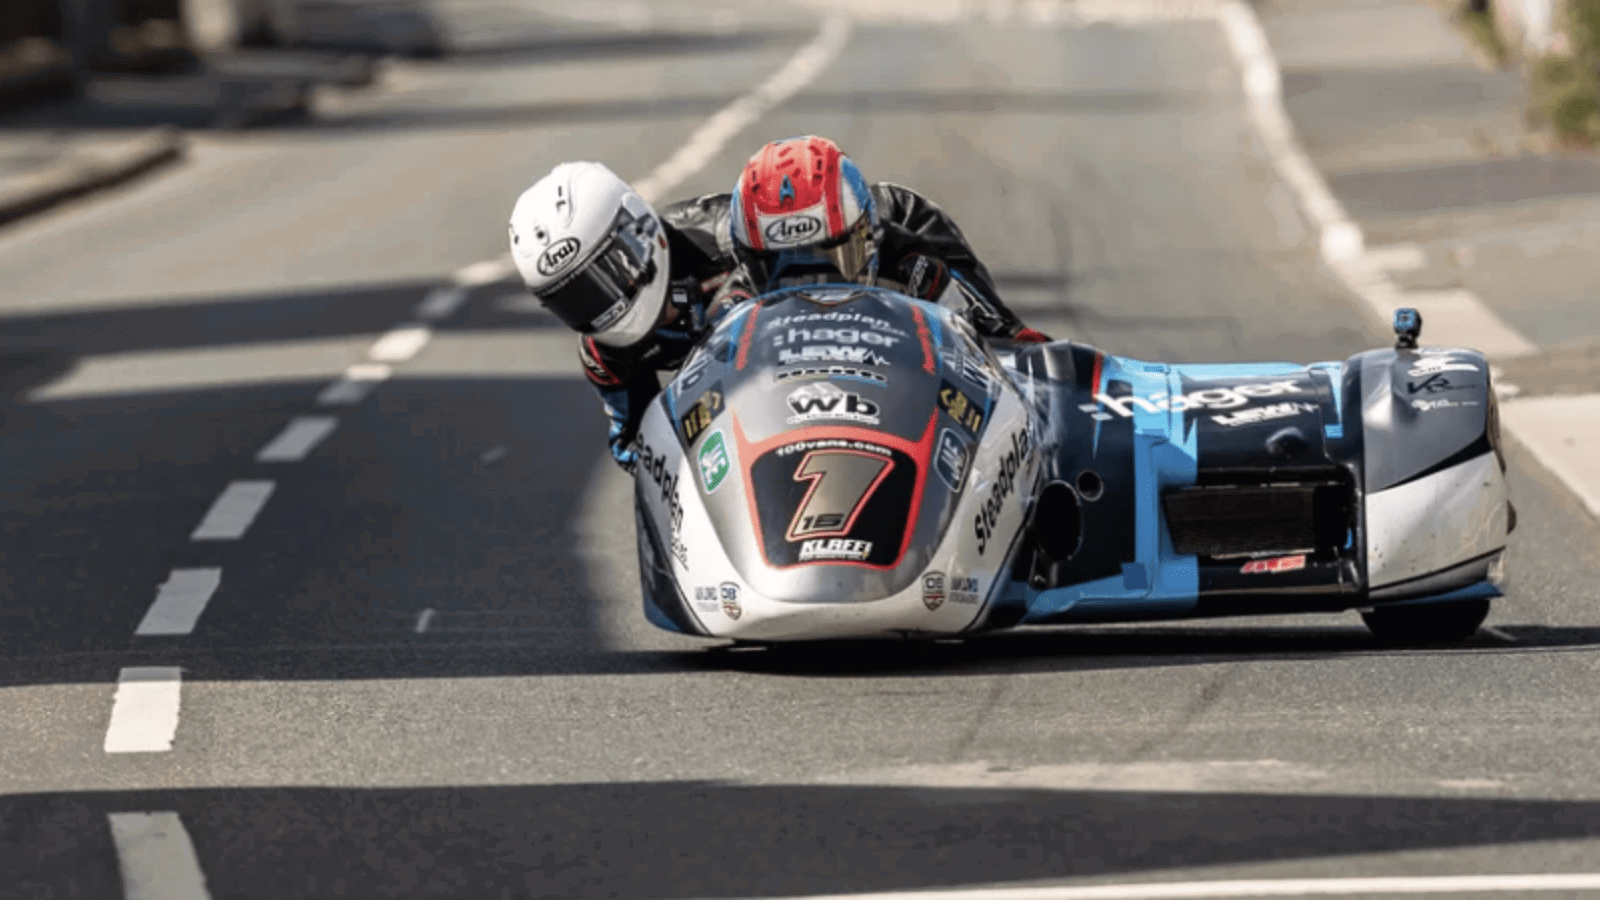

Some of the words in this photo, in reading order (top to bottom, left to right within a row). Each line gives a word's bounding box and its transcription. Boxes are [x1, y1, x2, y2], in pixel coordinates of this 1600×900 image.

[766, 217, 815, 239] Arai
[543, 240, 576, 273] Arai
[775, 439, 892, 457] 100vans.com
[785, 449, 896, 542] 1
